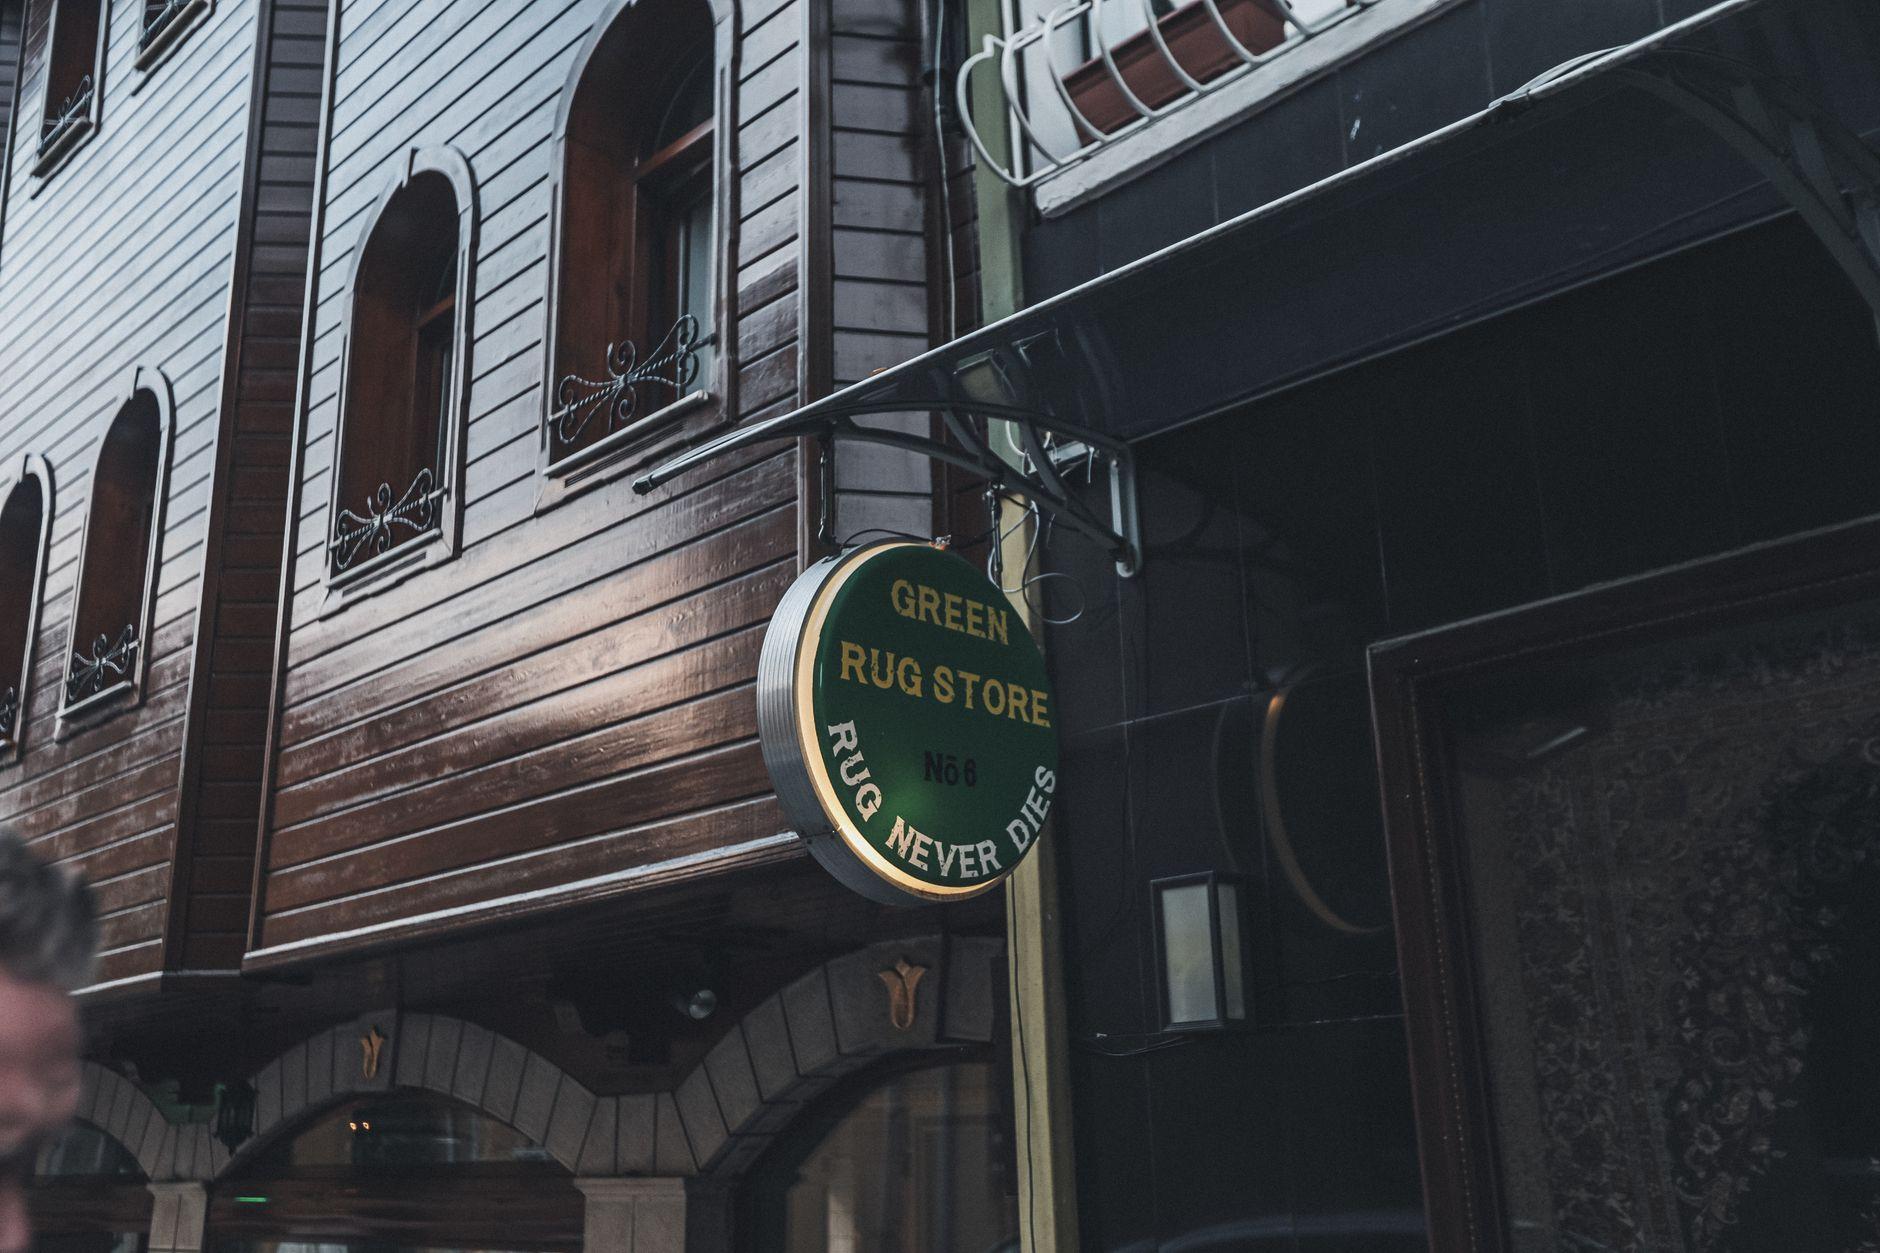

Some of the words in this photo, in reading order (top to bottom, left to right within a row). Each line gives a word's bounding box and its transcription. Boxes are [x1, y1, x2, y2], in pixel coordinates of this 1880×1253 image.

[891, 579, 1008, 645] GREEN
[840, 641, 922, 697] RUG
[932, 666, 1050, 728] STORE
[828, 720, 882, 822] RUG
[885, 815, 1001, 879] NEVER
[1006, 765, 1056, 853] DIES
